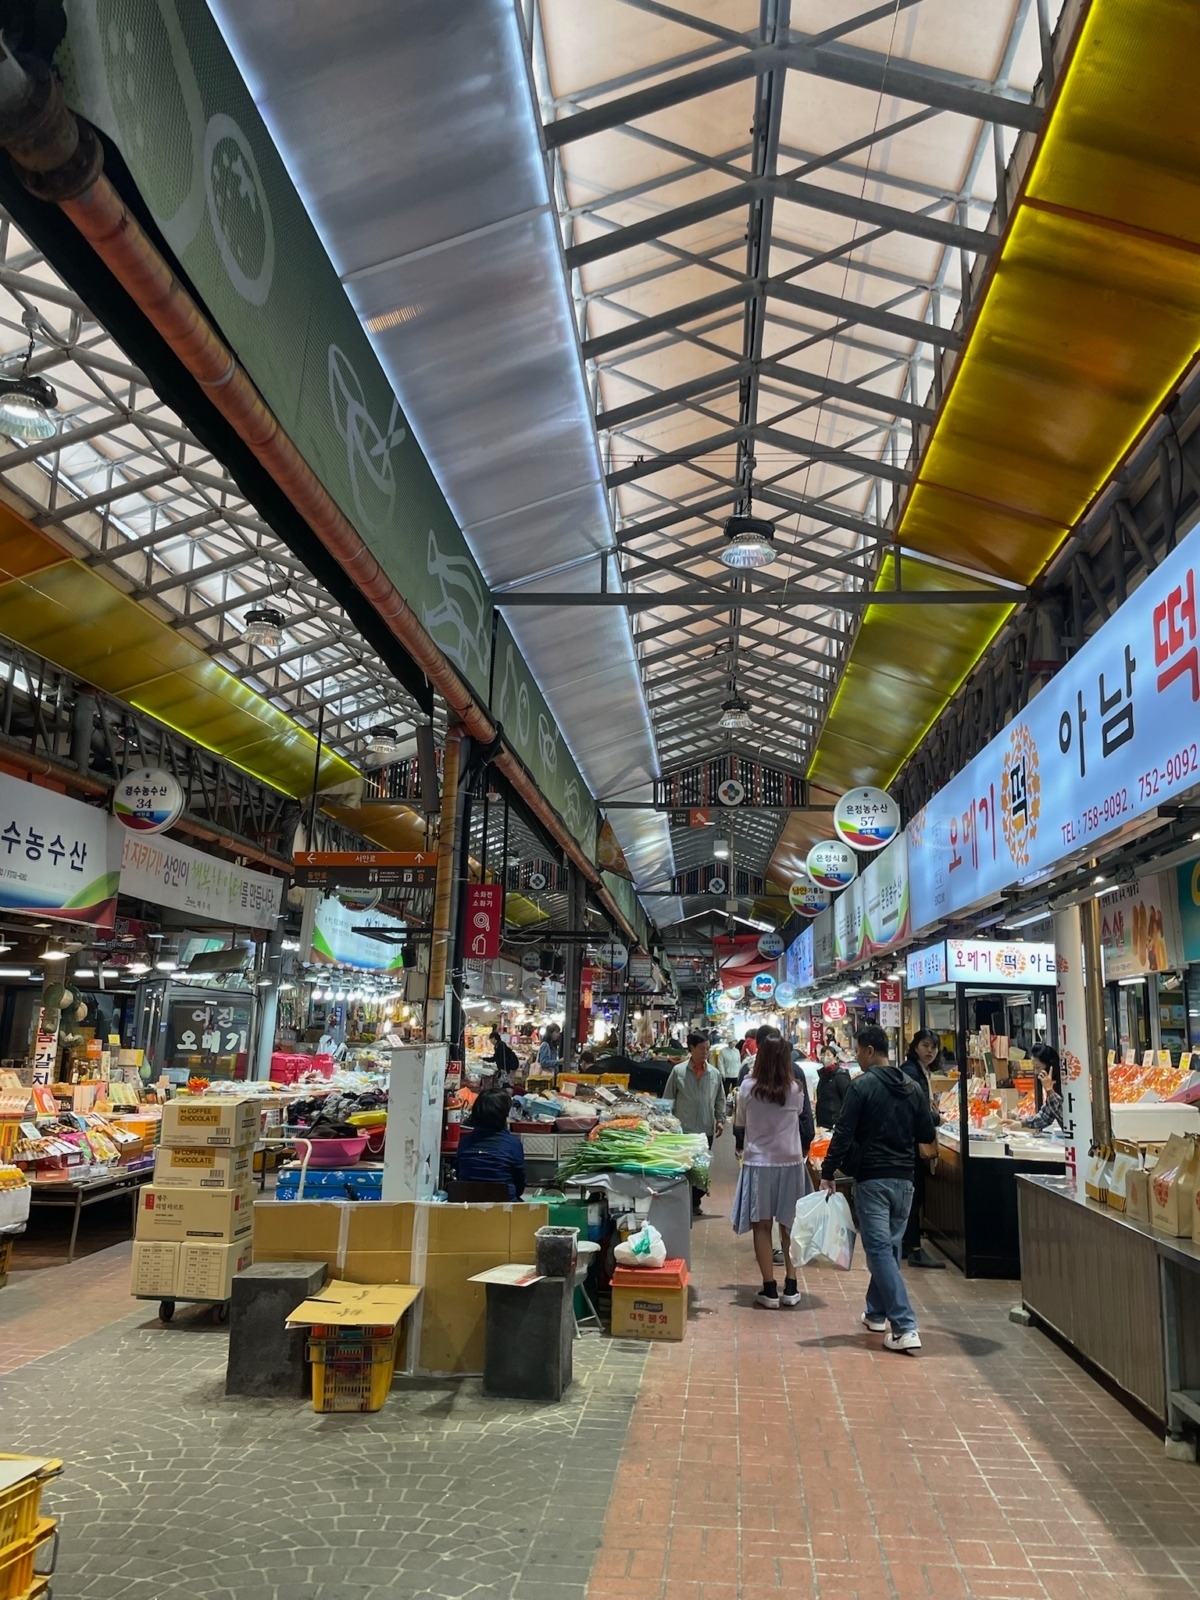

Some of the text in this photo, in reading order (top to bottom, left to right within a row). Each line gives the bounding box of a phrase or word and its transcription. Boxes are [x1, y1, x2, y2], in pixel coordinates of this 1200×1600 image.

[949, 783, 996, 873] 오메기
[1010, 756, 1028, 825] 떡
[1058, 645, 1136, 778] 아남
[1153, 568, 1199, 702] 떡
[1138, 743, 1198, 801] 752-9092
[125, 786, 167, 796] 경수농수산
[136, 798, 152, 809] 34
[846, 803, 888, 814] 은정농수산
[860, 816, 875, 827] 57
[1, 820, 87, 872] 수농수산
[130, 841, 164, 876] 지키기!
[163, 854, 190, 888] 상인이
[355, 854, 376, 863] 서안로
[816, 854, 848, 862] 은정식품
[826, 864, 838, 872] 55
[473, 891, 493, 899] 소화전
[955, 950, 991, 972] 오메기
[1004, 954, 1017, 970] 떡
[826, 1000, 843, 1018] 쌀
[192, 1006, 234, 1029] 여진
[176, 1029, 247, 1054] 오메기
[32, 1053, 55, 1085] 갈치
[173, 1156, 212, 1164] CHOCOLATE
